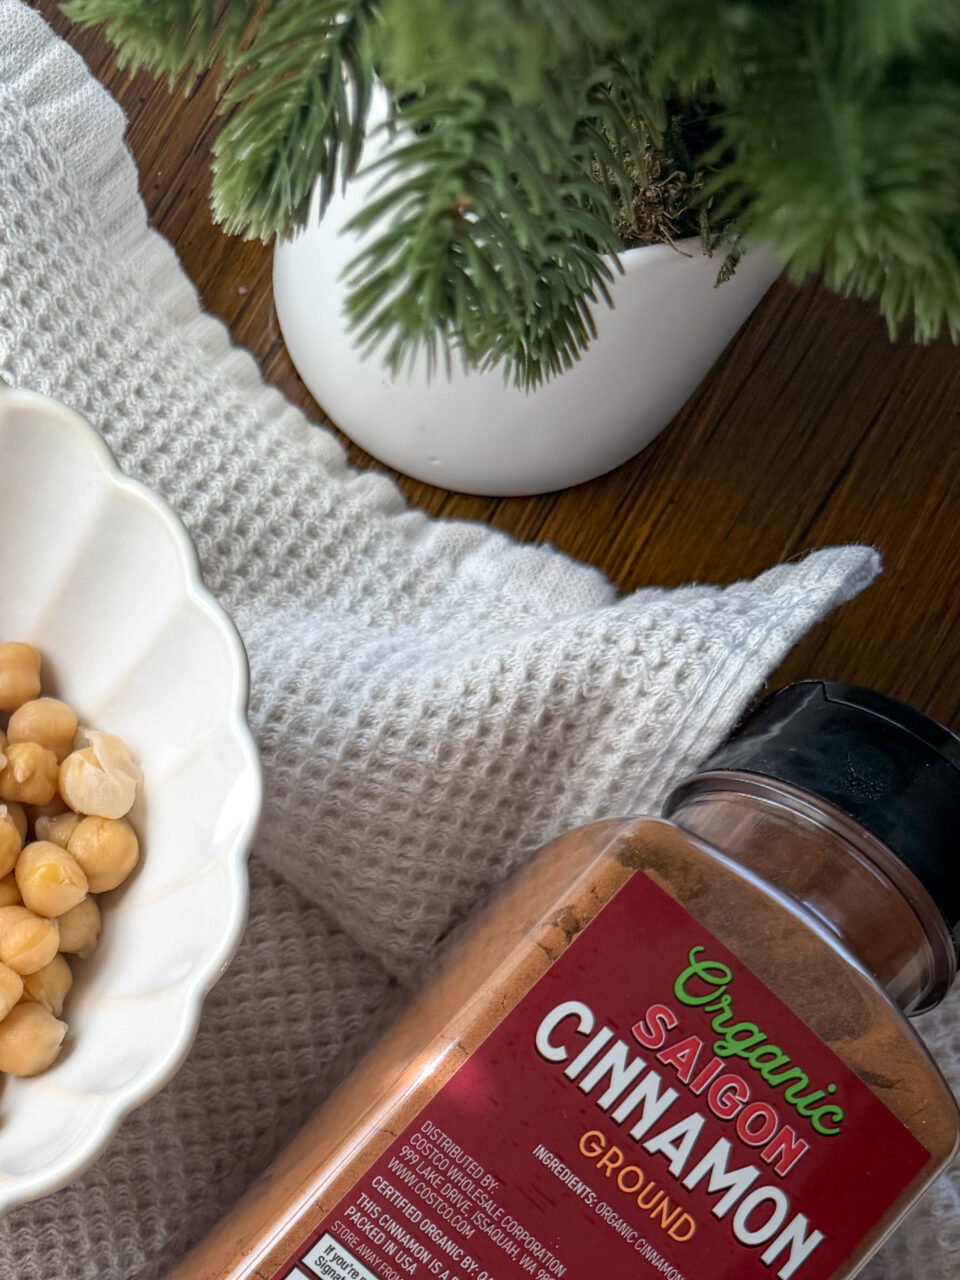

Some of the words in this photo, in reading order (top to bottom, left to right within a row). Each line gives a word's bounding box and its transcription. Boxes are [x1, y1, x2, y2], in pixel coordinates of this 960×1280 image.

[631, 1003, 809, 1177] SAIGON
[674, 946, 842, 1134] Organic
[419, 1118, 485, 1181] DISTRIBUTED
[478, 1172, 501, 1195] BY:
[535, 1000, 823, 1280] CINNAMON
[579, 1130, 695, 1241] GROUND
[329, 1218, 360, 1249] STORE
[353, 1241, 382, 1269] AWAY
[342, 1204, 387, 1247] PACKED
[381, 1239, 398, 1257] IN
[392, 1249, 420, 1276] USA
[353, 1191, 383, 1220] THIS
[376, 1212, 432, 1265] CINNAMON
[426, 1257, 444, 1275] IS
[369, 1173, 424, 1225] CERTIFIED
[417, 1216, 465, 1263] ORGANIC
[458, 1254, 481, 1277] BY:
[385, 1155, 476, 1241] WWW.COSTCO.COM
[396, 1143, 421, 1168] 999
[414, 1159, 445, 1190] LAKE
[438, 1181, 475, 1218] DRIVE,
[468, 1209, 524, 1262] ISSAQUAH,
[516, 1252, 539, 1275] WA
[407, 1130, 451, 1173] COSTCO
[444, 1164, 505, 1222] WHOLESALE
[498, 1213, 568, 1279] CORPORATION
[530, 1141, 600, 1208] INGREDIENTS:
[592, 1199, 639, 1245] ORGANIC
[322, 1243, 336, 1258] If
